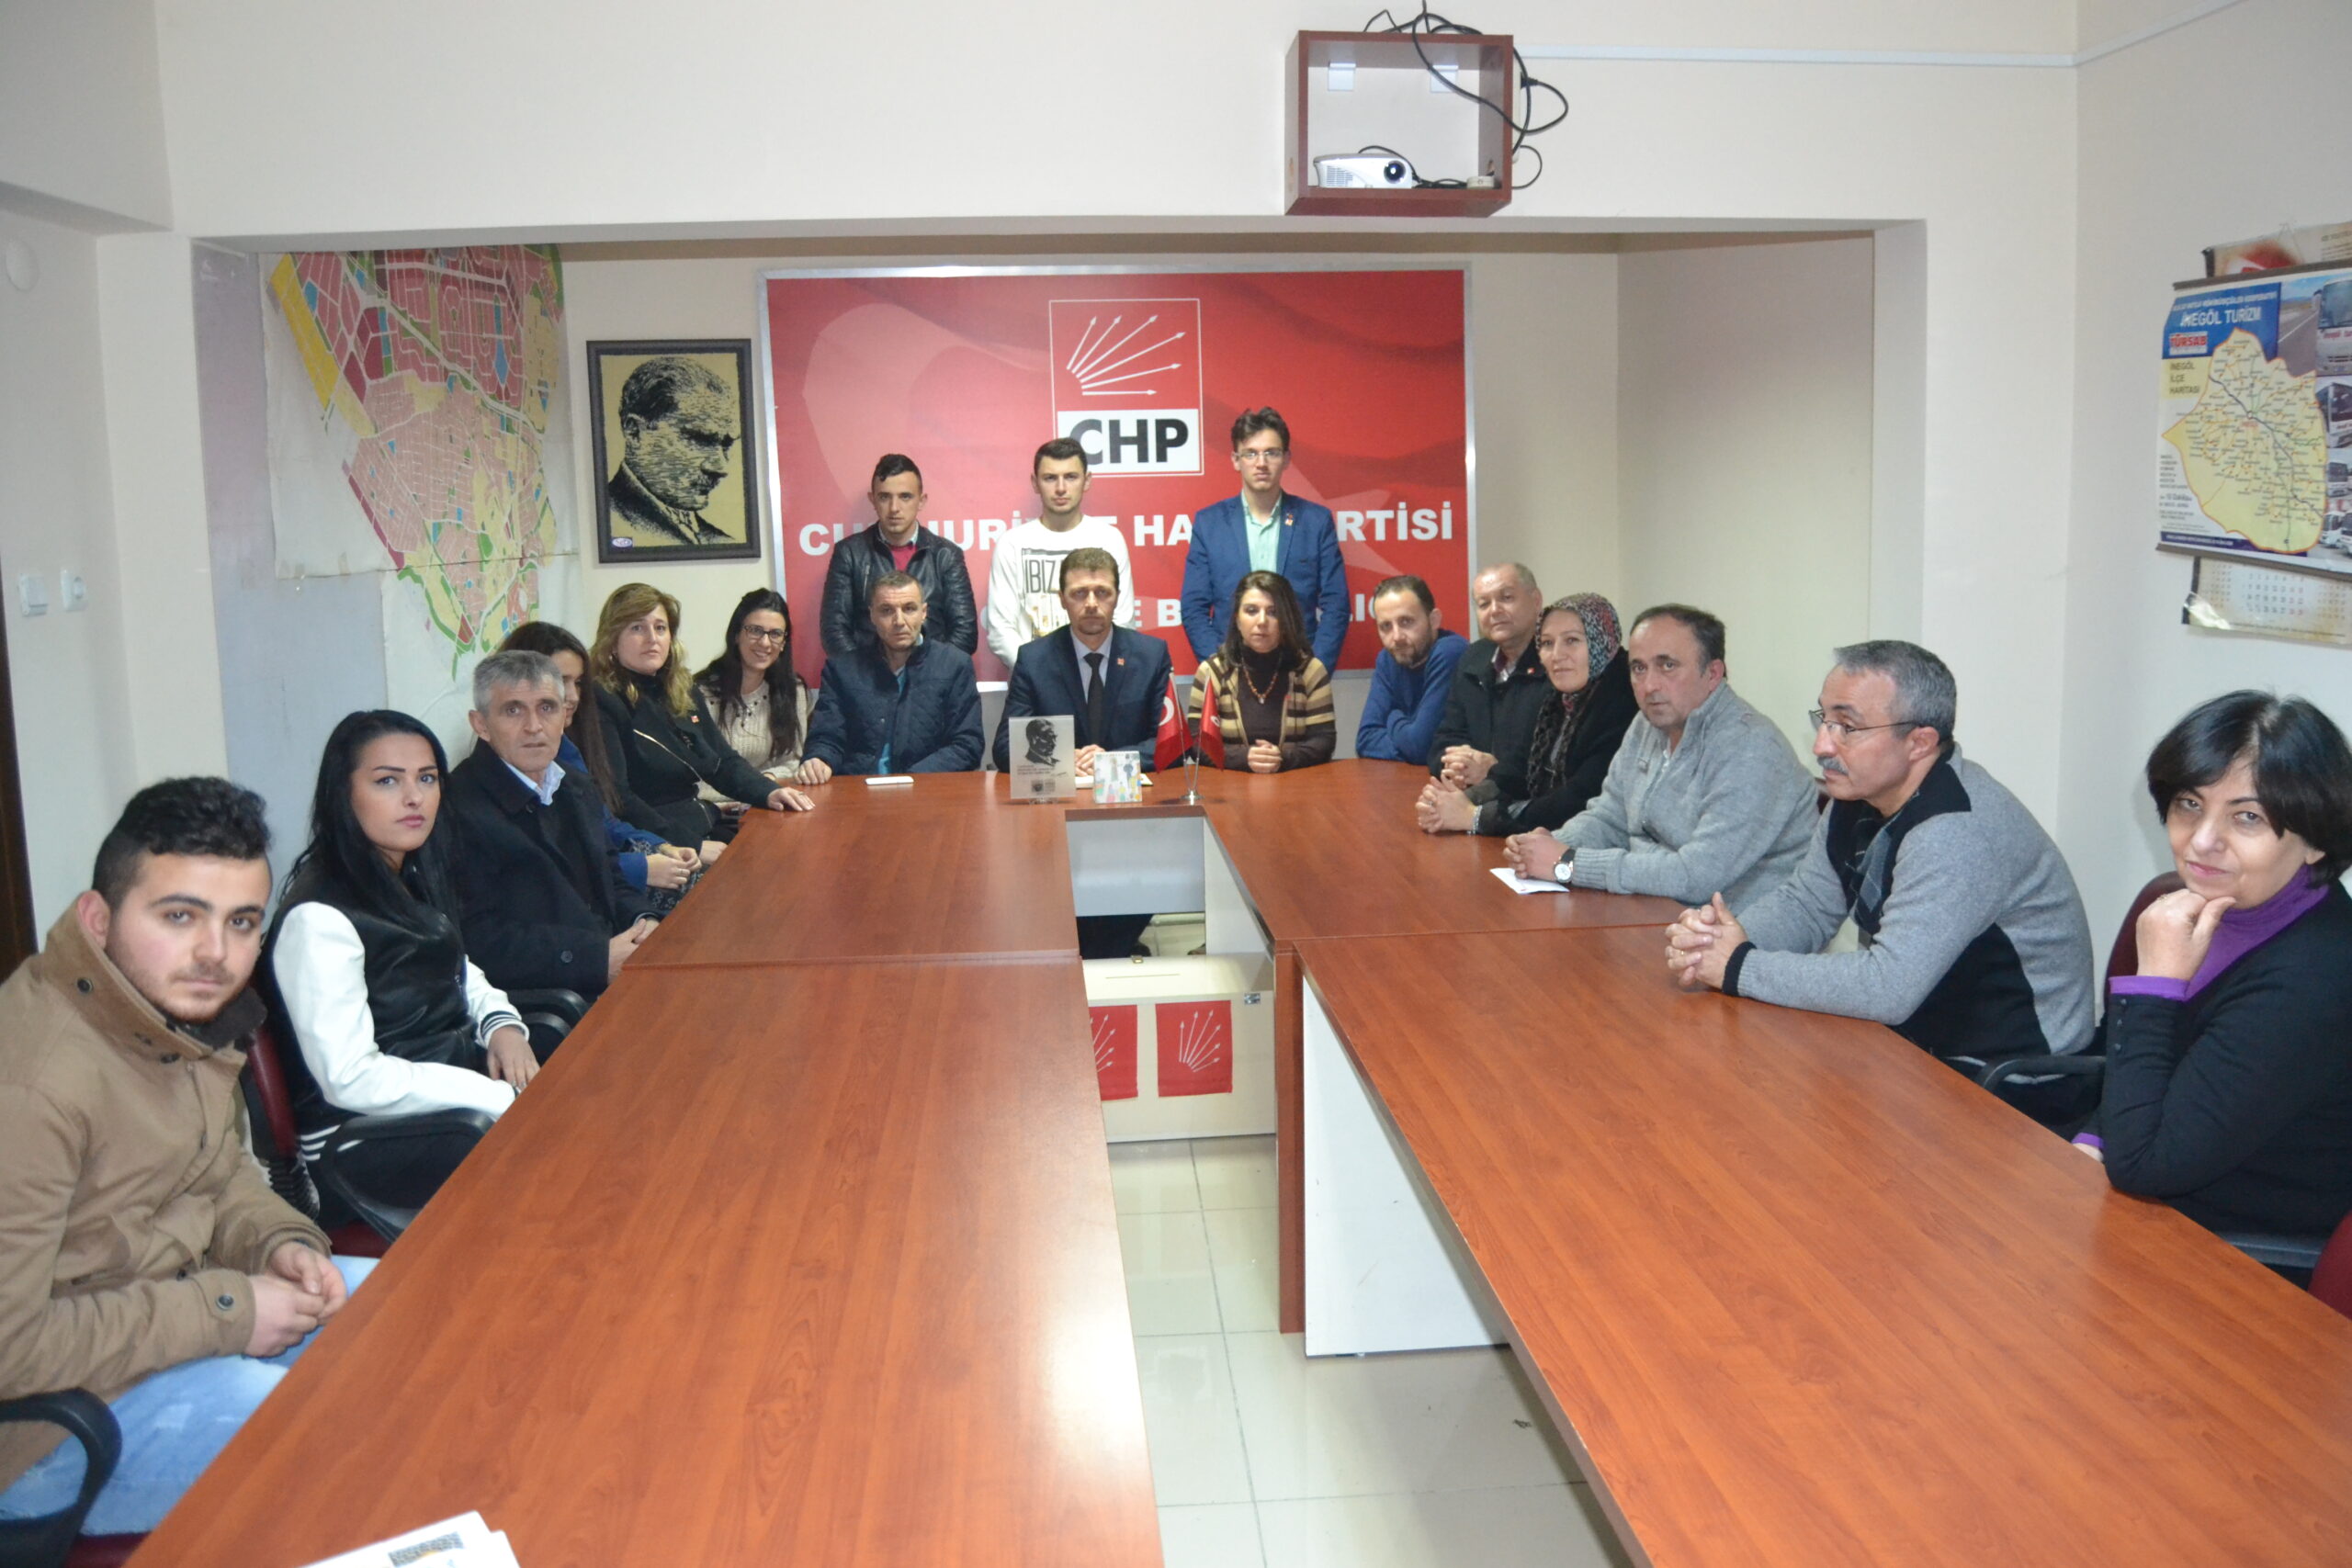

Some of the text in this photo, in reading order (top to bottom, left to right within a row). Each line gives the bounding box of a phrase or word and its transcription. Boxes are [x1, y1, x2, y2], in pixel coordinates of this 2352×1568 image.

[1070, 418, 1189, 466] CHP
[1134, 513, 1193, 547] HA
[1337, 501, 1453, 542] RTİSİ
[1024, 559, 1062, 594] IBIZ
